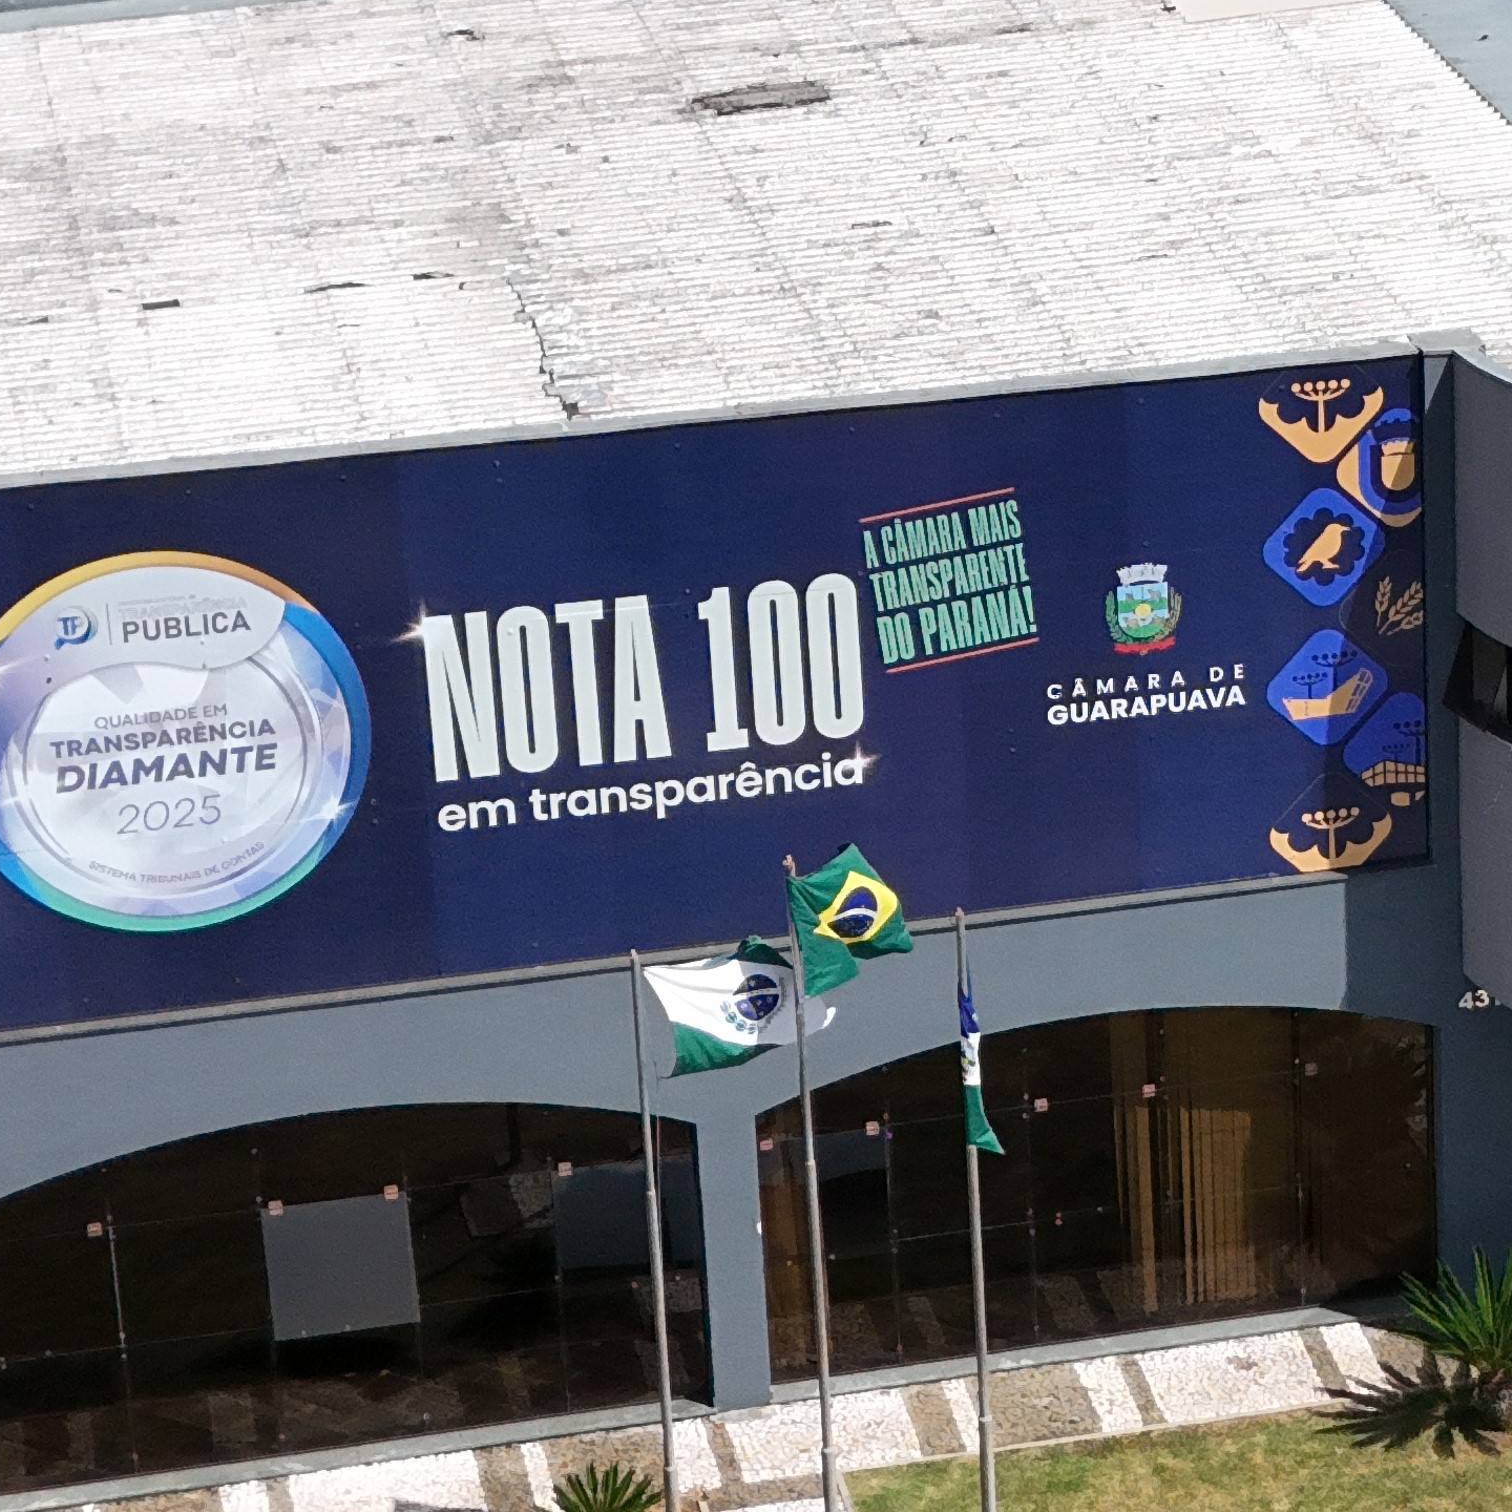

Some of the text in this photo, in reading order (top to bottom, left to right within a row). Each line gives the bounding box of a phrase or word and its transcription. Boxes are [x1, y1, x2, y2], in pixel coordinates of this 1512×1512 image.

[863, 499, 1022, 569] A CÂMARA MAIS
[869, 542, 1030, 612] TRANSPARENTE
[876, 584, 1038, 664] DO PARANÁ!
[422, 572, 864, 783] NOTA 100
[1046, 663, 1245, 700] CÂMARA DE
[94, 703, 228, 730] QUALIDADE EM
[1046, 685, 1246, 726] GUARAPUAVA
[50, 718, 276, 759] TRANSPARÊNCIA
[56, 743, 278, 794] DIAMANTE
[437, 752, 864, 831] em transparência
[117, 794, 222, 835] 2025
[89, 860, 137, 881] SISTEMA
[221, 841, 265, 870] CONTAS
[1458, 989, 1502, 1009] 43
